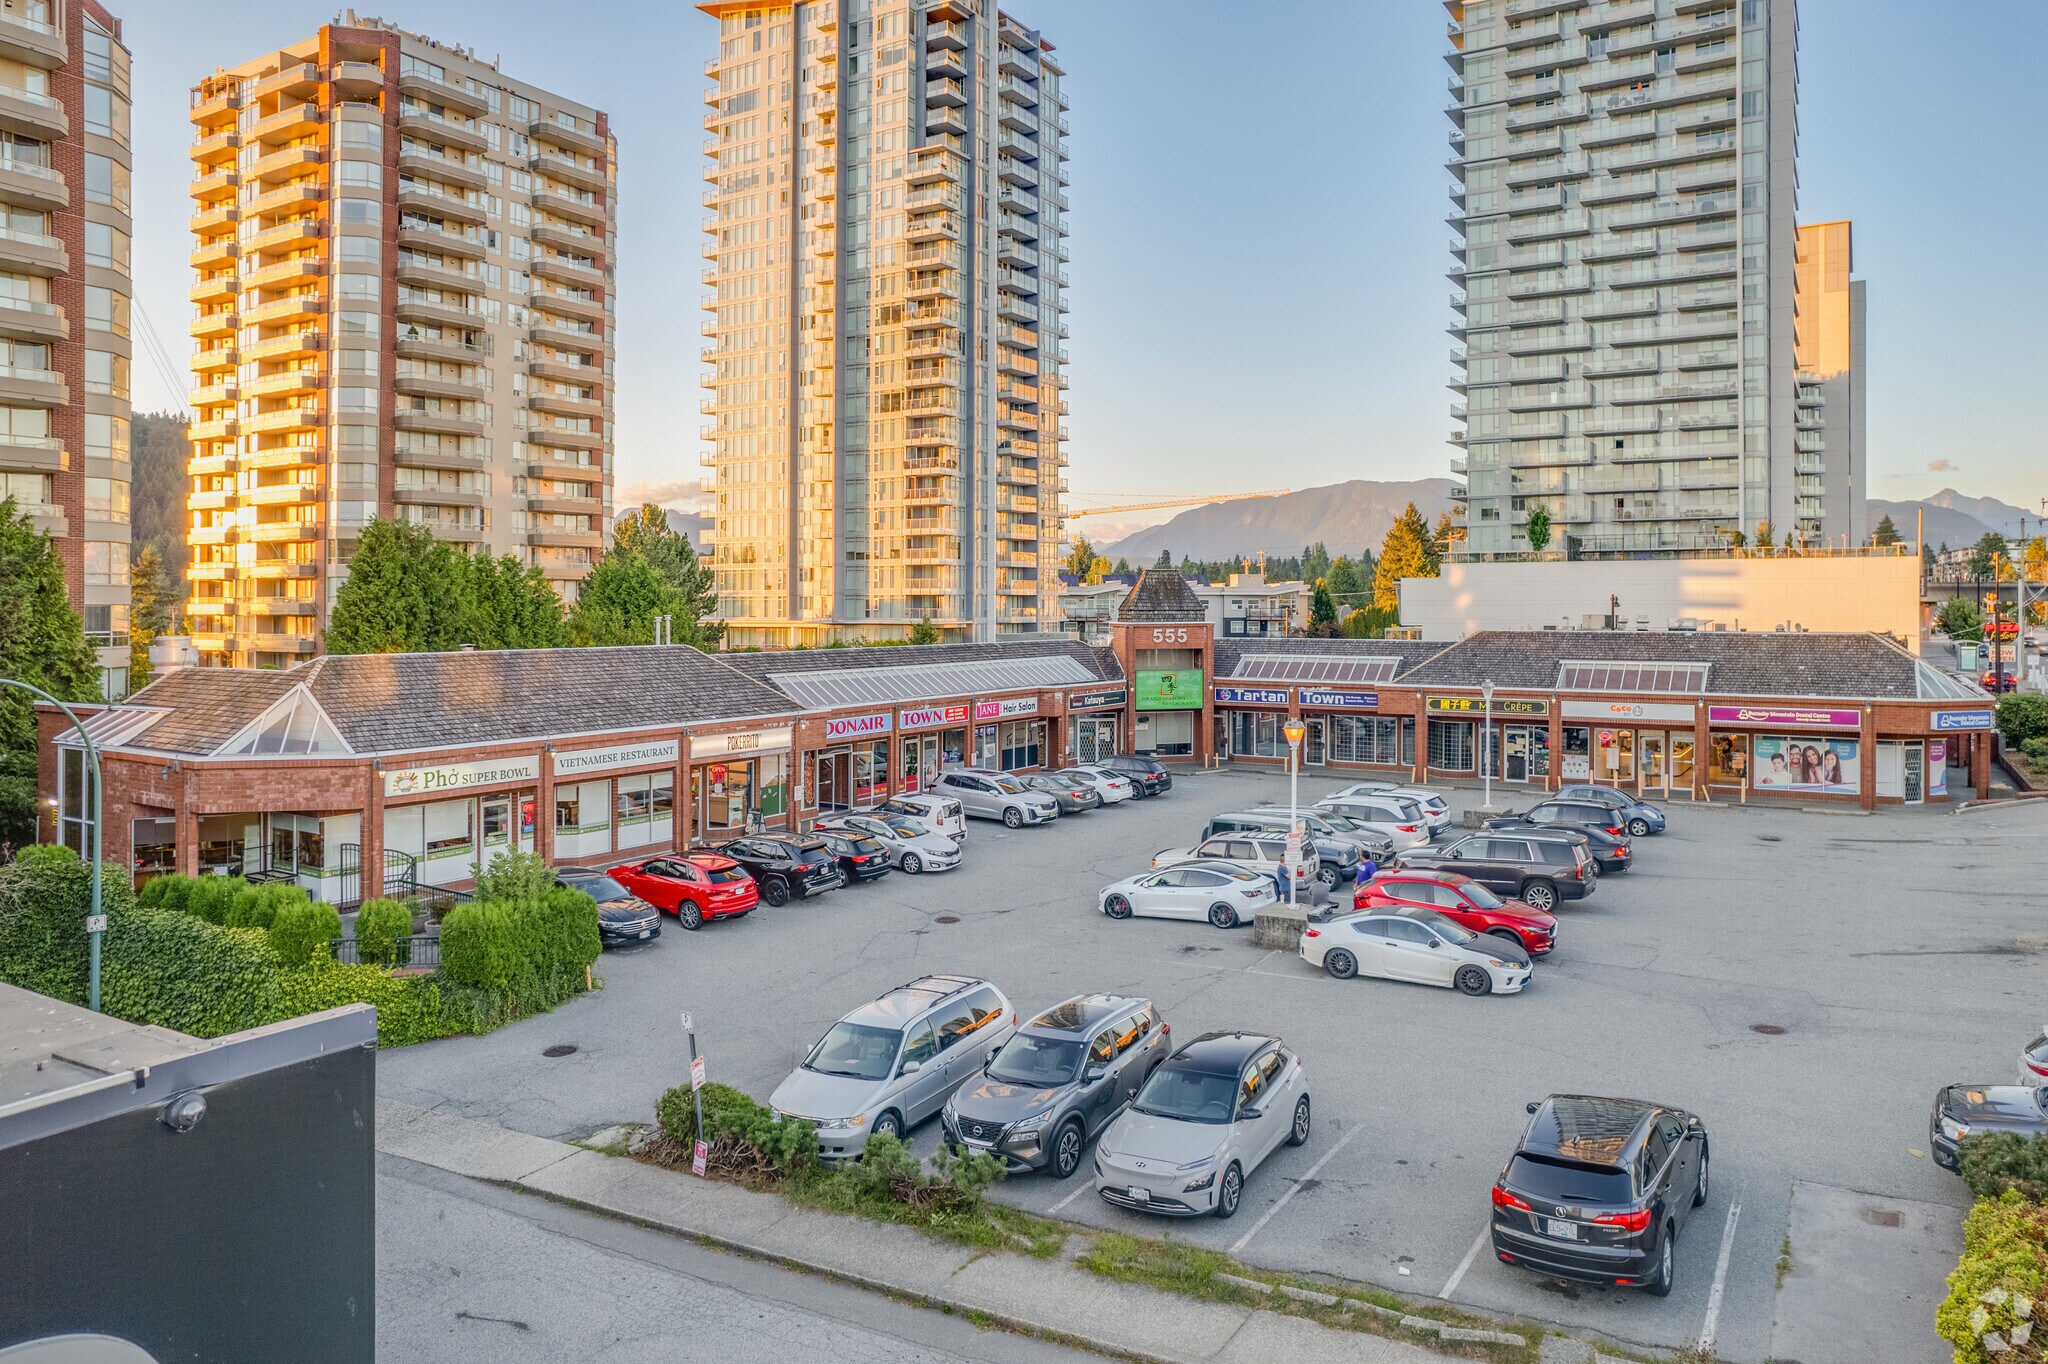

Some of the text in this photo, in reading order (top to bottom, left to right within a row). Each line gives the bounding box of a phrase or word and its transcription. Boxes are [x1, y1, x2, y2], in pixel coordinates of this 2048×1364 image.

[1153, 628, 1188, 643] 555
[1235, 689, 1286, 703] Tartan
[1303, 692, 1344, 705] Town
[980, 705, 998, 717] JANE
[1003, 702, 1036, 714] Hair Salon
[827, 716, 884, 735] DONAIR
[903, 710, 943, 726] TOWN
[728, 733, 758, 751] POKERRITO
[560, 746, 674, 768] VIETNAMESE RESTAURANT
[423, 767, 531, 788] Phở SUPER BOWL
